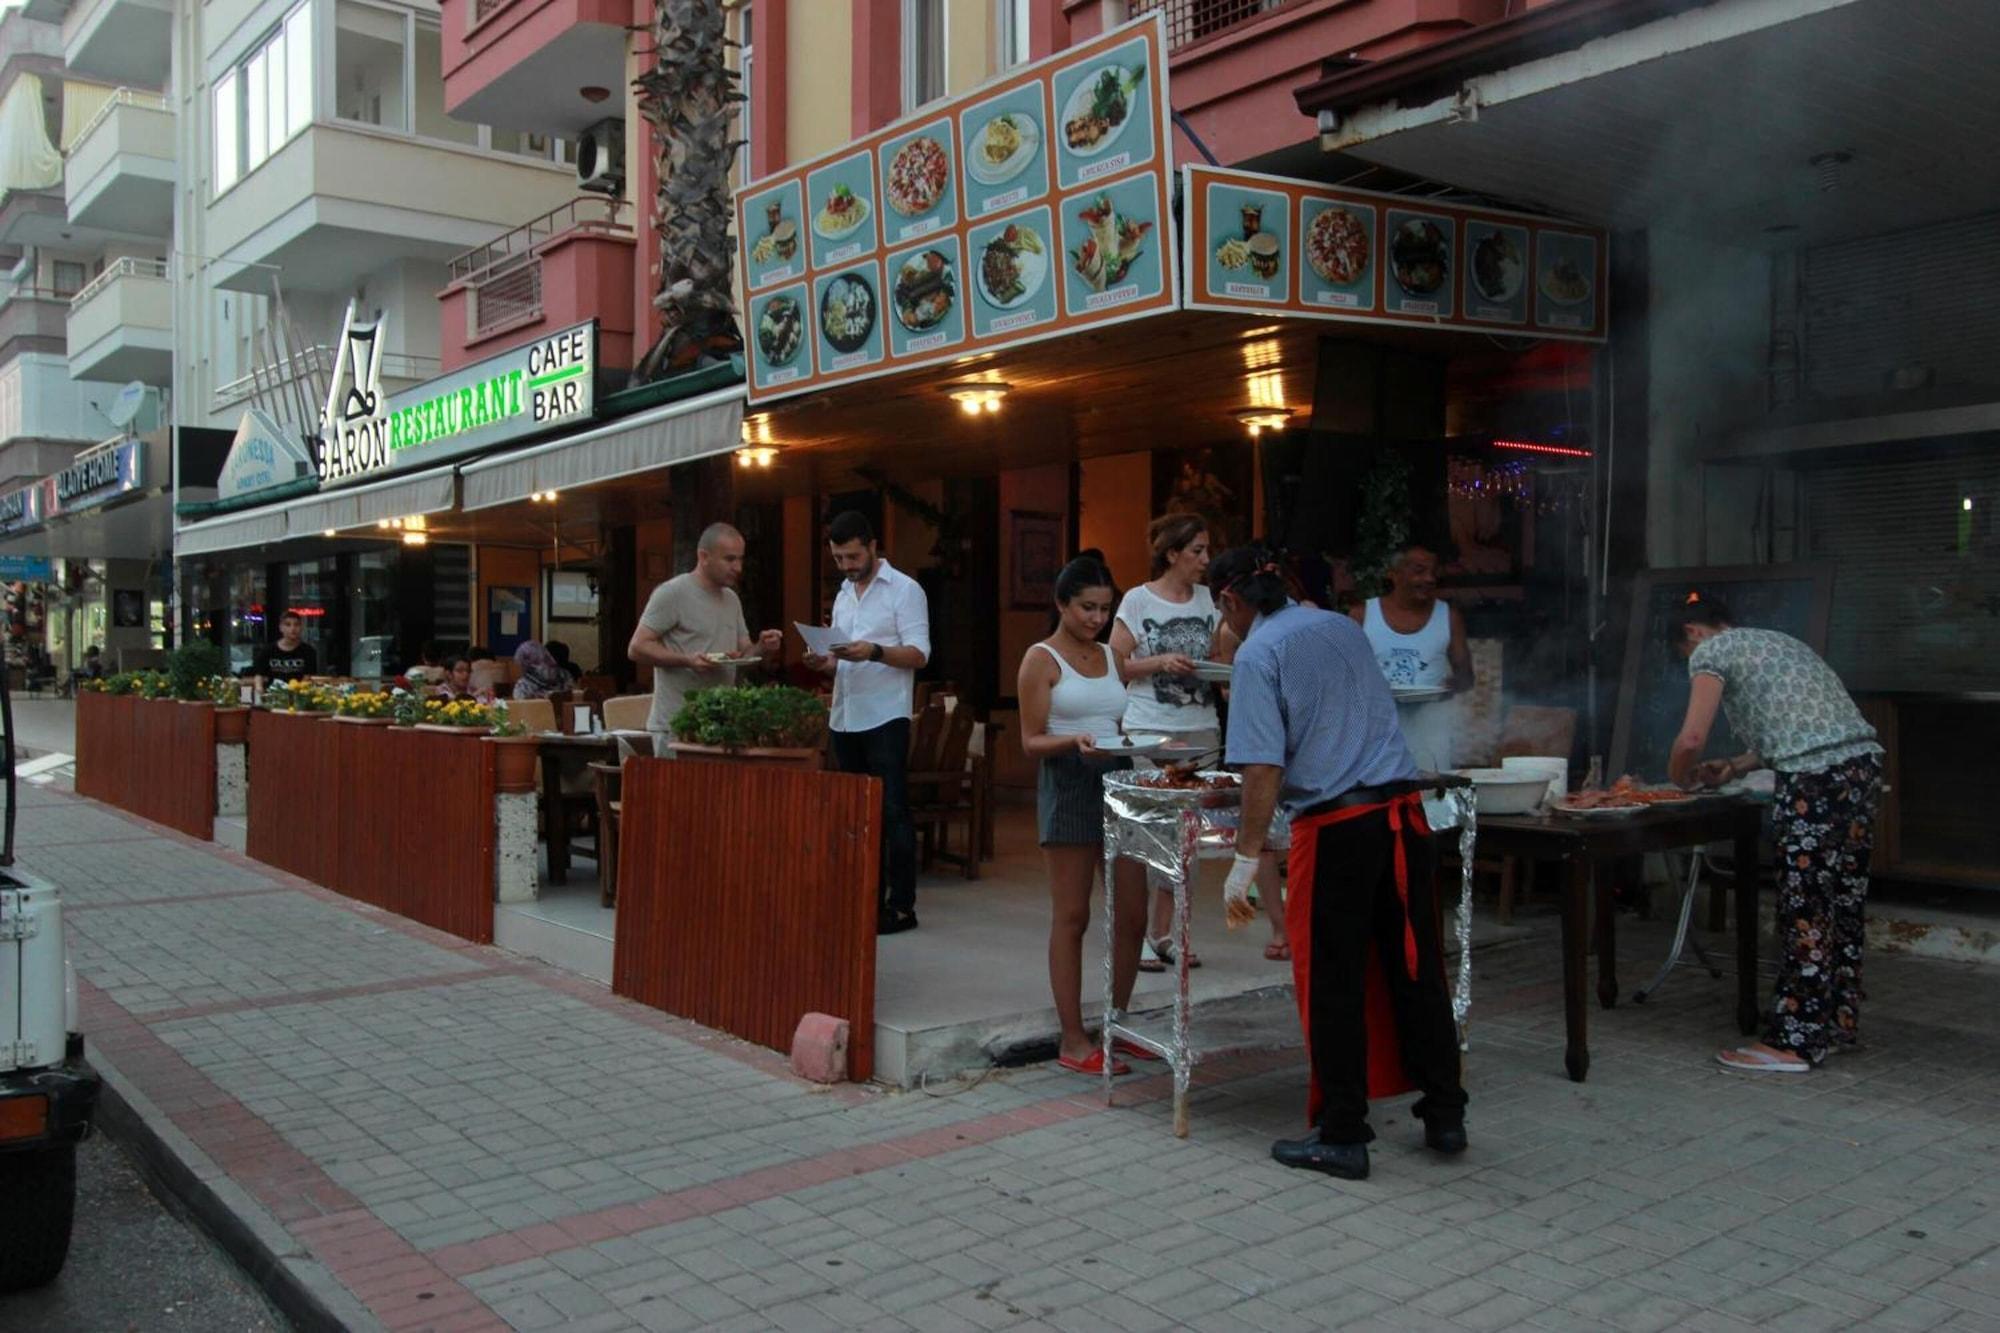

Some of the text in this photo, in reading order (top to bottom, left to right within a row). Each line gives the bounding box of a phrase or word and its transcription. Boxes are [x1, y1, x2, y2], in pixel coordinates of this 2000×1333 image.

[529, 330, 584, 376] CAFE
[533, 381, 577, 422] BAR
[318, 369, 523, 481] BARON RESTAURANT
[88, 449, 119, 488] HOME
